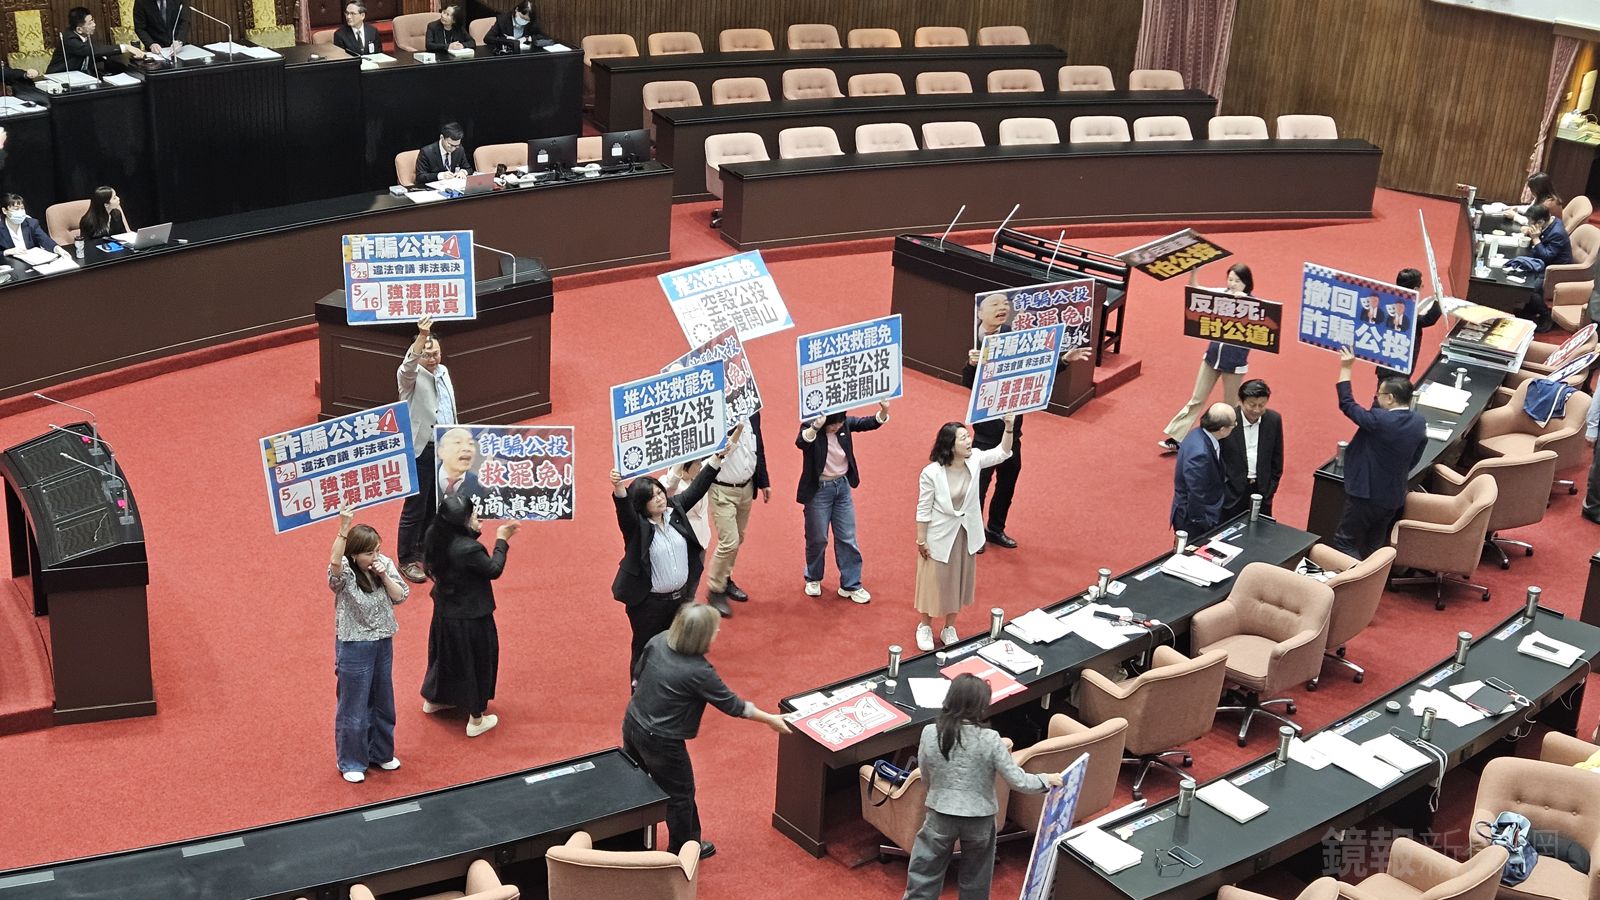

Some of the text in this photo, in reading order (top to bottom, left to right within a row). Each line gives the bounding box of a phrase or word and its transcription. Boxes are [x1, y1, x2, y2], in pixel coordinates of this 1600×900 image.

[351, 235, 446, 260] 詐騙公投
[373, 264, 416, 275] 違法會議
[419, 262, 461, 273] 非法表決
[353, 285, 379, 309] 5/16
[387, 282, 458, 300] 強渡關山
[388, 298, 459, 316] 弄假成真
[701, 281, 768, 316] 空殼公投
[1013, 286, 1091, 311] 詐騙公投
[1304, 278, 1358, 318] 撤回
[808, 324, 892, 362] 推公投救罷免
[988, 329, 1048, 360] 詐騙公投
[1200, 316, 1274, 346] 討公道!
[1301, 307, 1410, 362] 詐騙公投
[825, 348, 890, 383] 空殼公投
[624, 369, 715, 414] 推公投救罷免
[825, 372, 890, 407] 強渡關山
[644, 396, 714, 438] 空殼公投
[274, 414, 381, 463] 詐騙公投
[479, 433, 571, 457] 詐騙公投
[645, 423, 715, 466] 強渡關山
[277, 437, 401, 481] 3/25 違法會議 非法表決
[478, 460, 572, 489] 救罷免!
[320, 460, 400, 495] 強渡關山
[323, 477, 403, 512] 弄假成真
[282, 488, 312, 511] 5/16
